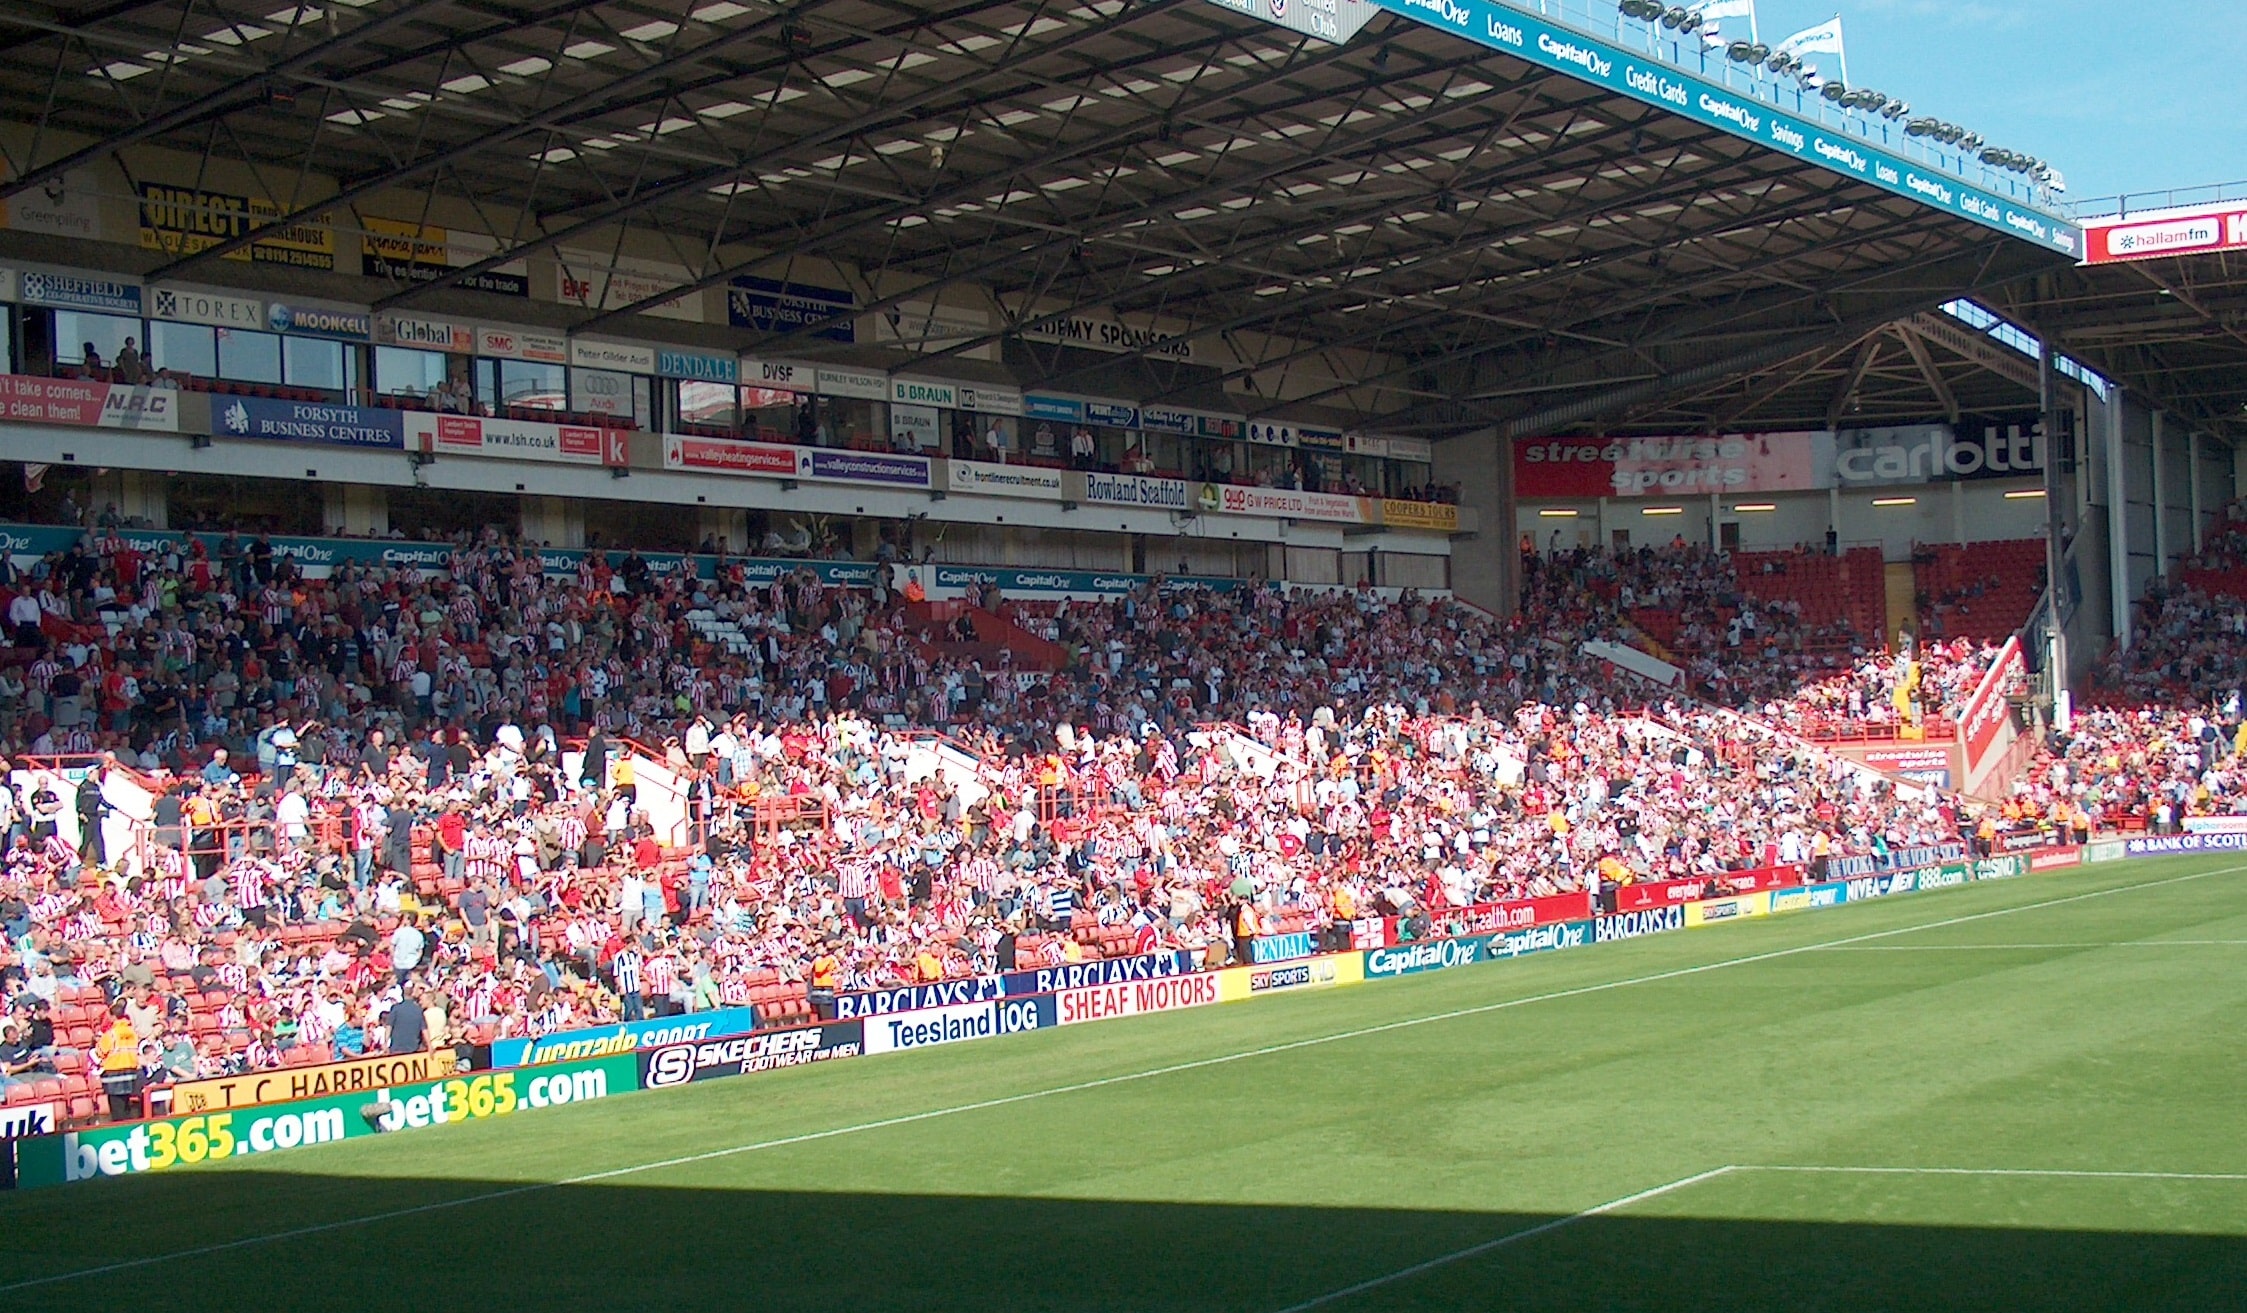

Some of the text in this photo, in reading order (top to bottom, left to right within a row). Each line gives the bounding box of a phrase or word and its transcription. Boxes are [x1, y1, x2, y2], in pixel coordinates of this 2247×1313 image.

[1311, 13, 1337, 37] Club
[1487, 13, 1523, 47] Loans
[1538, 33, 1612, 78] CapitalOne
[1625, 65, 1658, 94] Credit
[1658, 78, 1688, 106] Cards
[1699, 93, 1760, 132] CapitalOne
[1770, 119, 1804, 152] Savings
[1813, 138, 1867, 173] CapitalOne
[1875, 160, 1899, 185] Loans
[21, 206, 91, 232] Greenpiling
[146, 187, 242, 237] DIRECT
[46, 274, 124, 298] SHEFFIELD
[478, 275, 494, 289] the
[495, 277, 519, 293] trade
[183, 297, 257, 322] TOREX
[752, 305, 802, 324] BUSNESS
[294, 311, 369, 334] MOONCELL
[397, 319, 451, 346] Global
[486, 335, 513, 352] SMC
[577, 348, 601, 360] Peter
[602, 349, 628, 363] Gilder
[629, 353, 649, 366] Audi
[662, 352, 735, 379] DENDALE
[762, 363, 793, 382] DVSF
[15, 381, 42, 398] take
[897, 383, 904, 399] B
[908, 385, 951, 404] BRAUN
[11, 401, 81, 420] clean them!
[293, 405, 358, 424] FORSYTH
[902, 415, 931, 428] BRAUN
[261, 419, 391, 443] BUSINESS CENTRES
[485, 431, 556, 449] www.lsh.co.uk
[1087, 474, 1185, 507] Rowland Scaffold
[1609, 465, 1746, 493] sports
[1263, 495, 1288, 511] PRICE
[1384, 499, 1426, 516] COOPERS
[383, 548, 449, 567] CapitalO
[1015, 574, 1071, 590] CapitalOne
[1865, 750, 1947, 762] streetwise
[1898, 758, 1947, 768] sports
[2147, 836, 2183, 851] BANK
[2183, 835, 2201, 849] OF
[1841, 853, 1874, 876] VODKA
[1847, 877, 1881, 902] NIVEA
[1918, 867, 1963, 890] 888.com
[1666, 881, 1700, 902] everyday
[1595, 905, 1664, 943] BARCLAYS
[1368, 940, 1477, 975] CapitalOne
[1036, 955, 1149, 993] BARCLAYS
[1252, 974, 1271, 990] SKY
[1272, 967, 1309, 987] SPORTS
[837, 979, 971, 1020] BARCLAYS
[1064, 975, 1216, 1022] SHEAF MOTORS
[888, 1007, 990, 1048] Teesland
[695, 1027, 823, 1068] SKECHERS
[740, 1049, 813, 1074] FOOTWEAR
[830, 1041, 861, 1060] MEN
[219, 1083, 236, 1107] T
[256, 1079, 272, 1103] C
[291, 1057, 429, 1098] HARRISON
[376, 1067, 608, 1133] bet365.com
[64, 1105, 345, 1183] bet365.com
